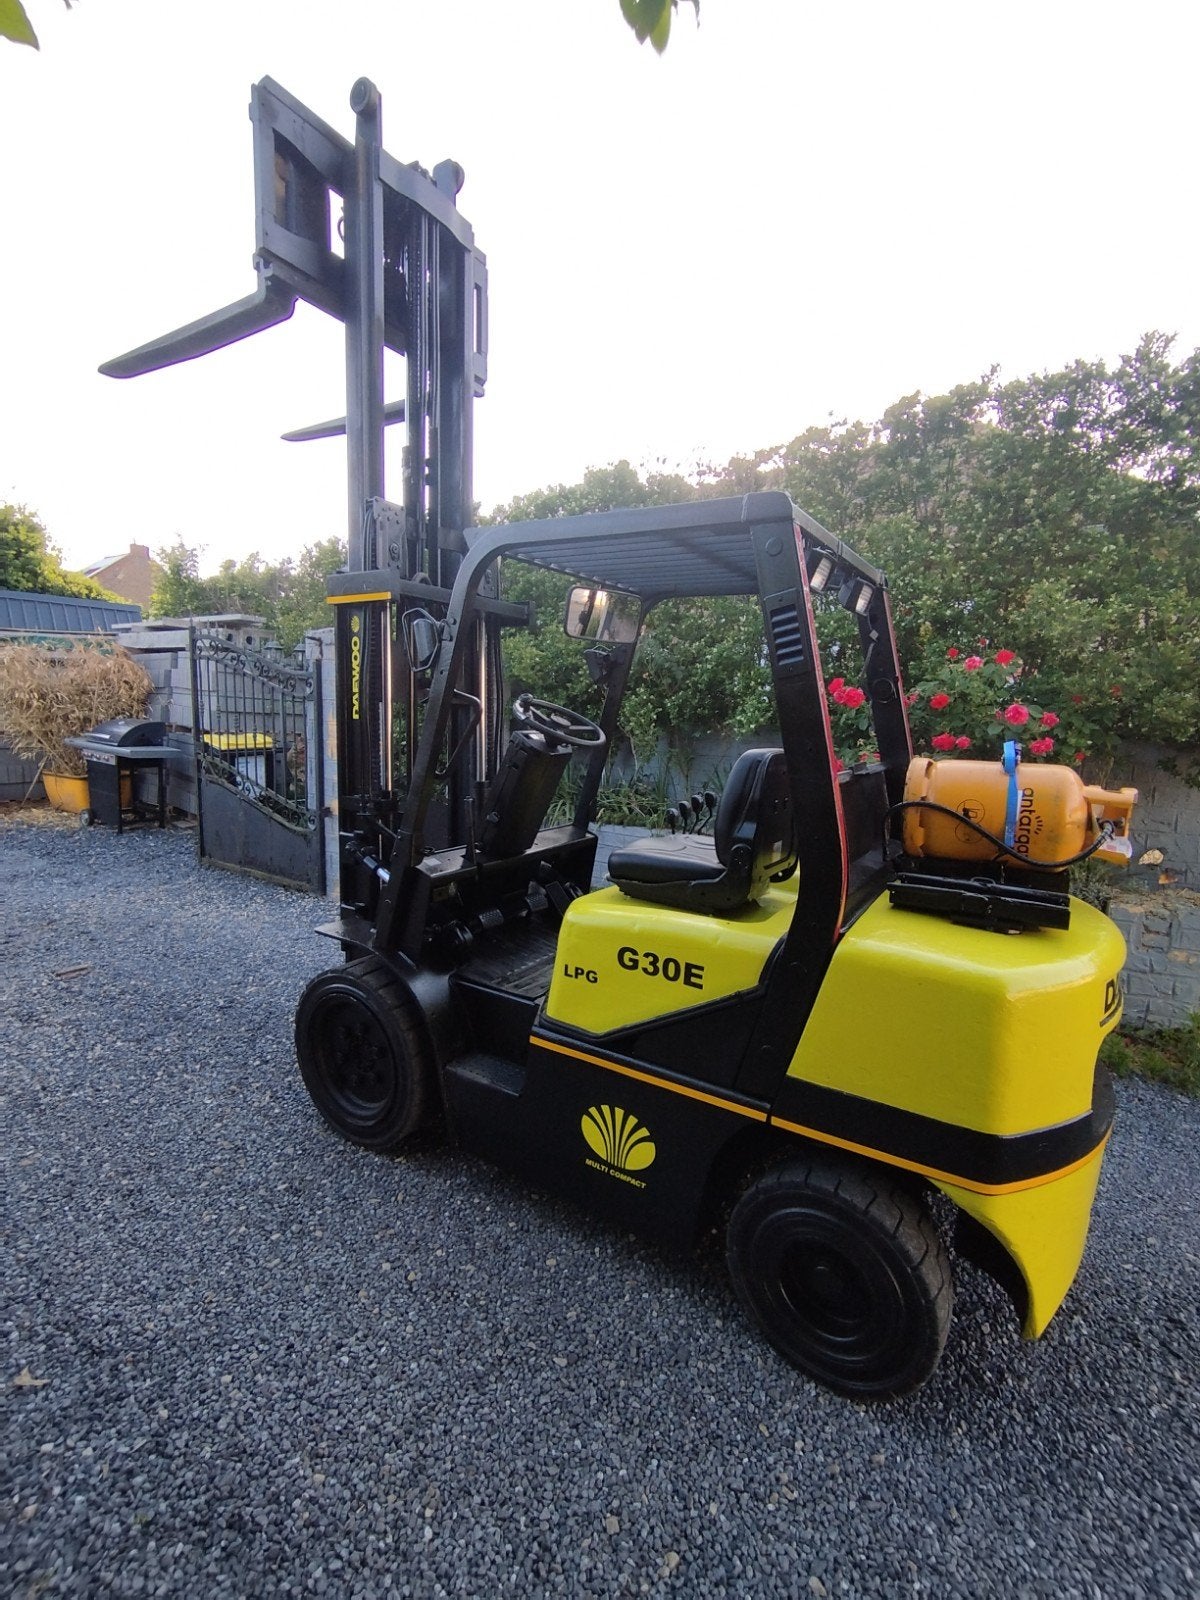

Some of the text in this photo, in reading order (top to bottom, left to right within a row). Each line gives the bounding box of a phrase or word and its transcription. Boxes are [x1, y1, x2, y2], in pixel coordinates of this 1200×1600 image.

[351, 636, 361, 720] DAEWOO
[1014, 787, 1036, 858] antarga
[564, 964, 599, 984] LPG
[617, 946, 705, 990] G30E
[585, 1158, 647, 1189] MULTI COMPACT
